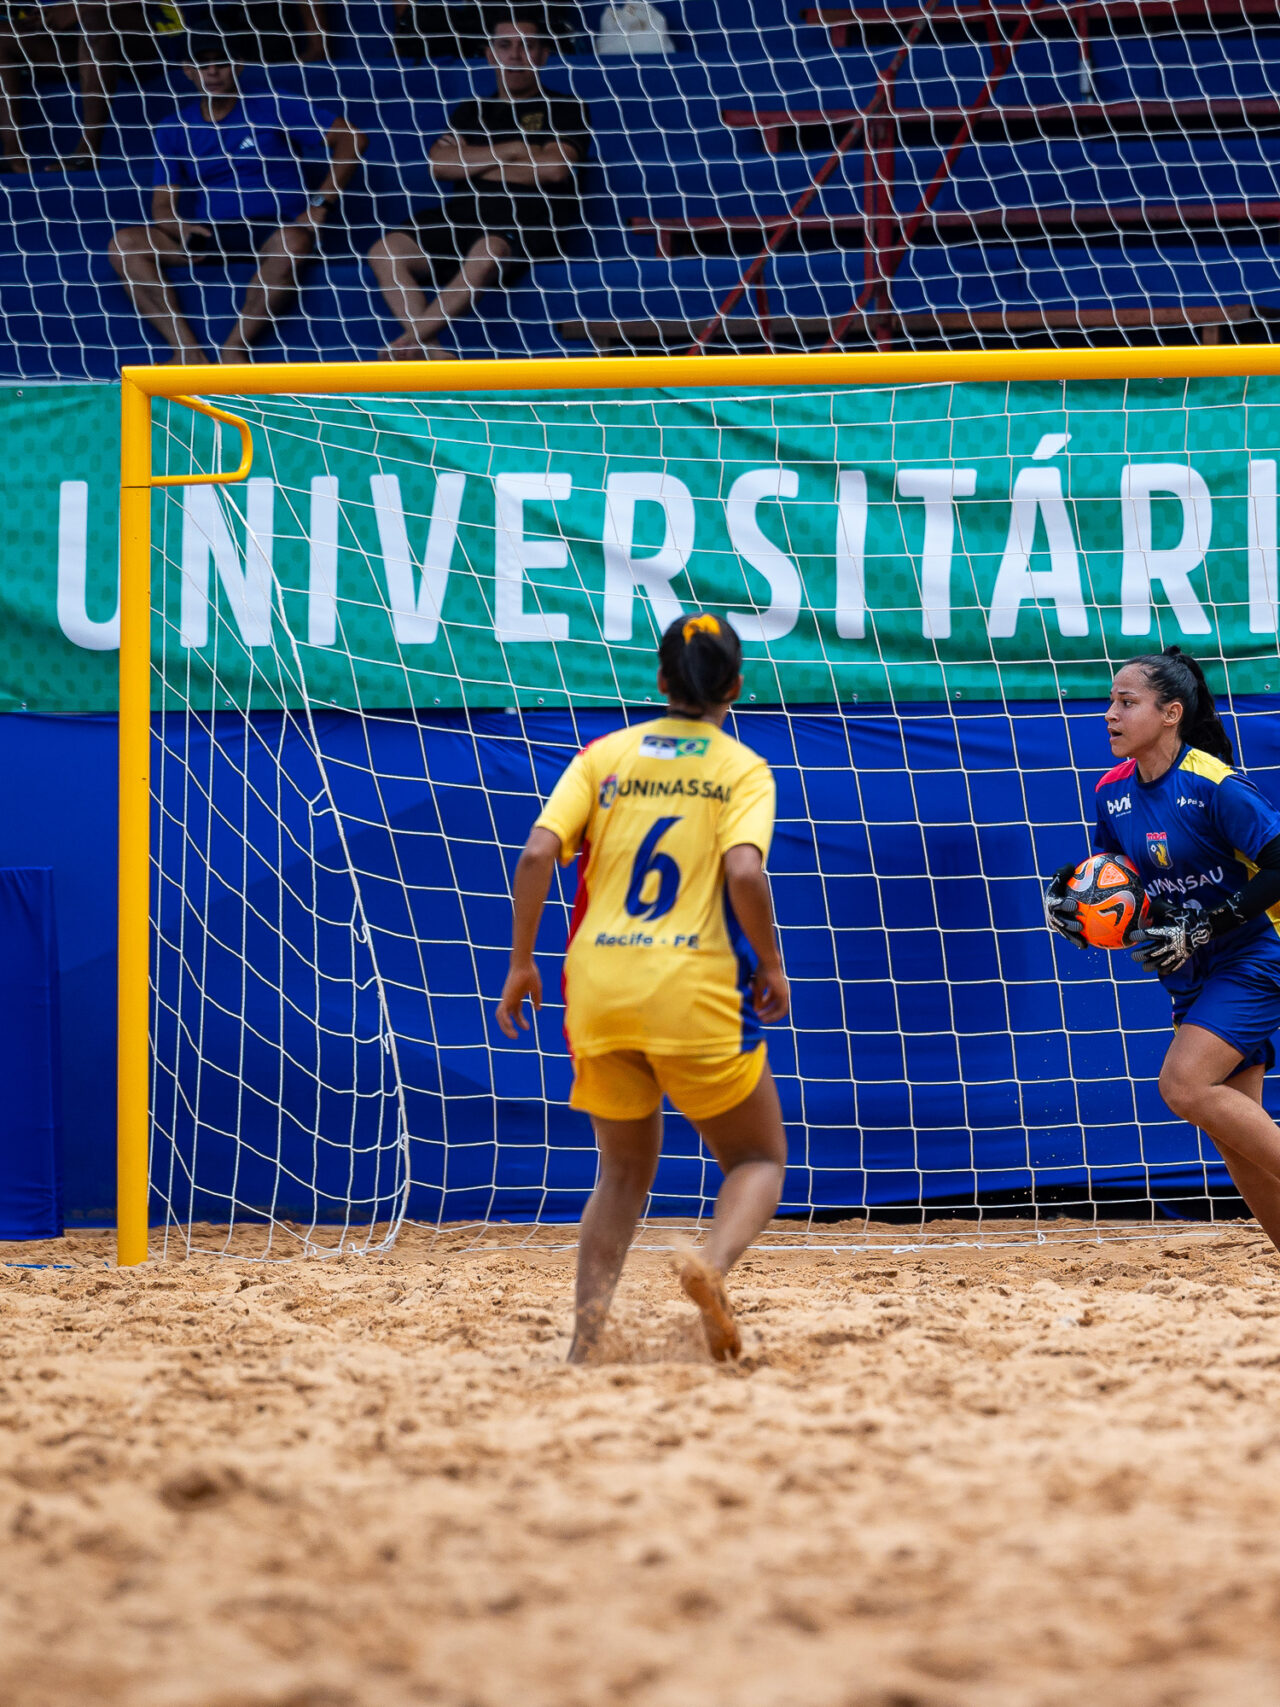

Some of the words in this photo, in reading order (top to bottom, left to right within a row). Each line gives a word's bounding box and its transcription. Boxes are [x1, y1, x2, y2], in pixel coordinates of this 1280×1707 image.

[624, 815, 683, 922] 6
[595, 933, 653, 947] Recife
[674, 934, 699, 949] PE
